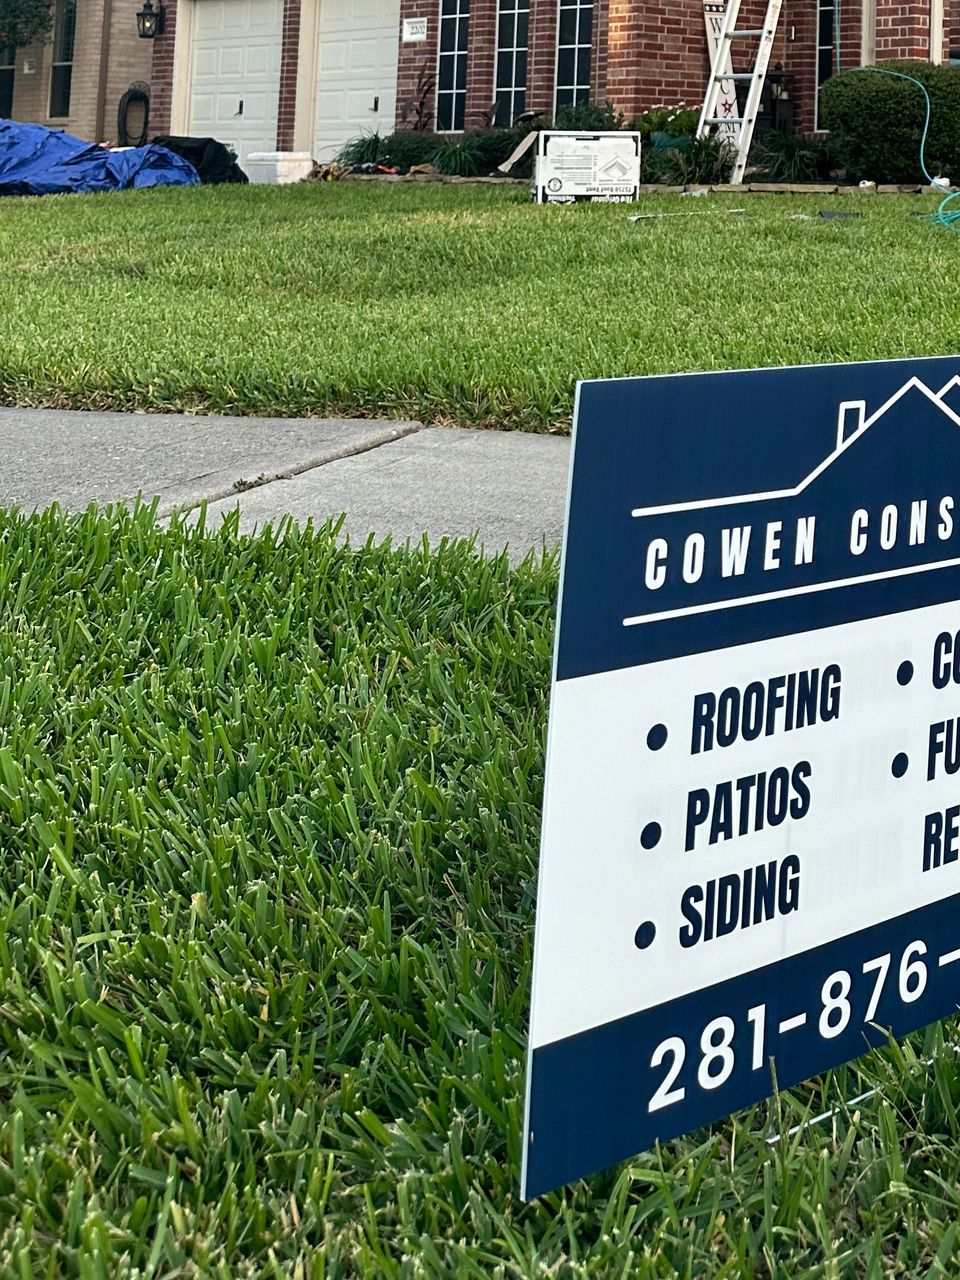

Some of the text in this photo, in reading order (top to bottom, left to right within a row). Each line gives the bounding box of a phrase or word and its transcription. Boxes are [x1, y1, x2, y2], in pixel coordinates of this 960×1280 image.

[645, 516, 816, 590] COWEN
[690, 663, 842, 756] ROOFING
[684, 760, 812, 853] PATIOS
[679, 854, 801, 949] SIDING
